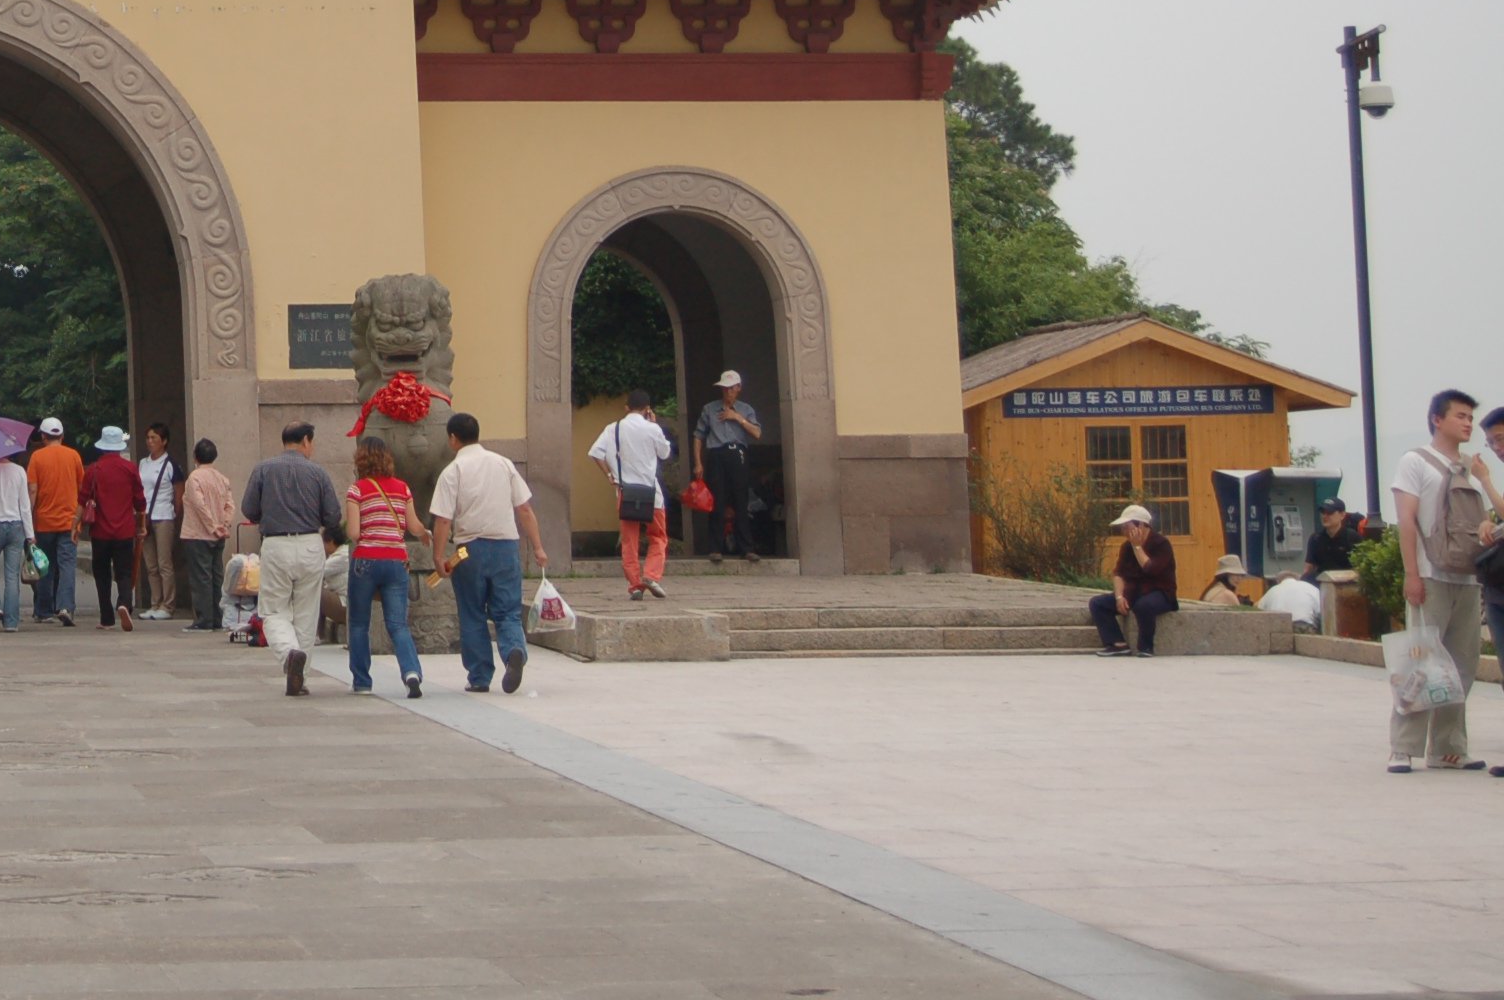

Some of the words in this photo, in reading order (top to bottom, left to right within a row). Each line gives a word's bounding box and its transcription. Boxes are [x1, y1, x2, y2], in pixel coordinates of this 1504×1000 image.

[1013, 389, 1261, 405] 普陀山客车公司旅游包车联系处
